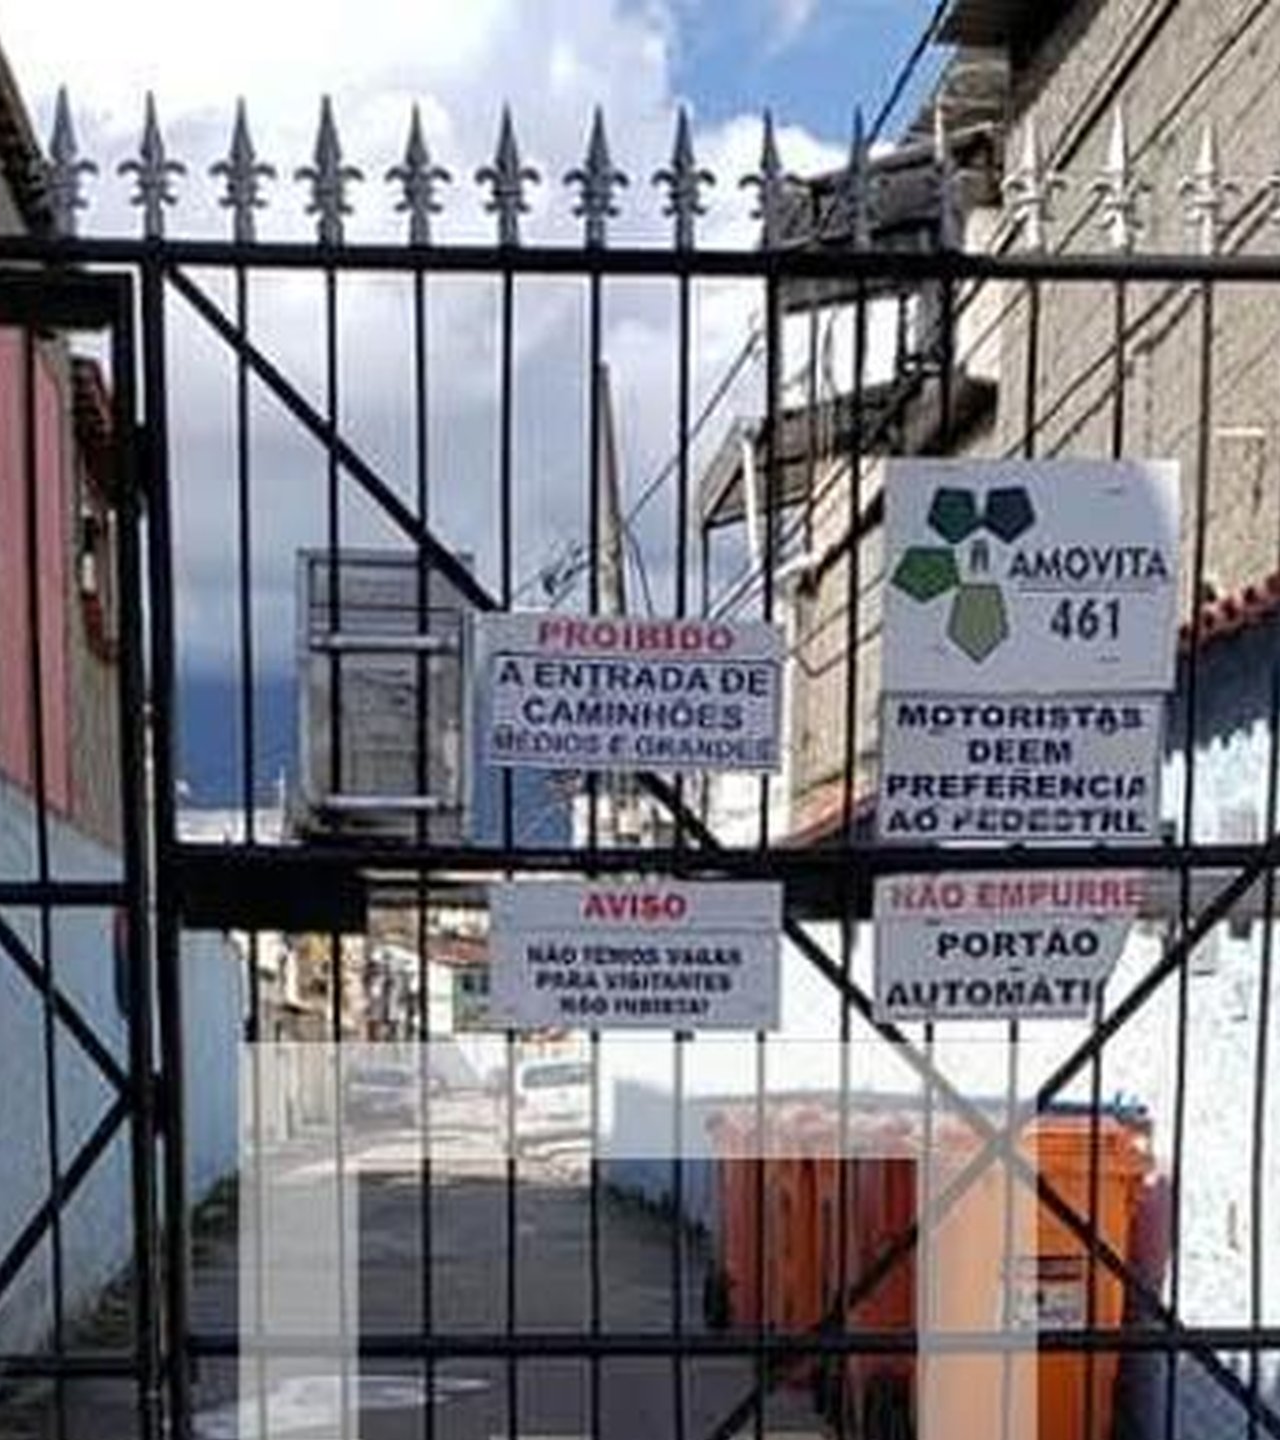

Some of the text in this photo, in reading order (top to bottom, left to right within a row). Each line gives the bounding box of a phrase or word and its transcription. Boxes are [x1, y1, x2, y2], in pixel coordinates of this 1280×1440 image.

[1008, 546, 1168, 580] AMOVITA
[1050, 598, 1120, 640] 461
[536, 619, 735, 652] PROIBIDO
[499, 661, 770, 697] A ENTRADA DE
[897, 704, 1142, 731] MOTORISTAS
[968, 738, 1071, 765] DEEM
[886, 808, 939, 834] AO
[584, 893, 687, 919] AVISO
